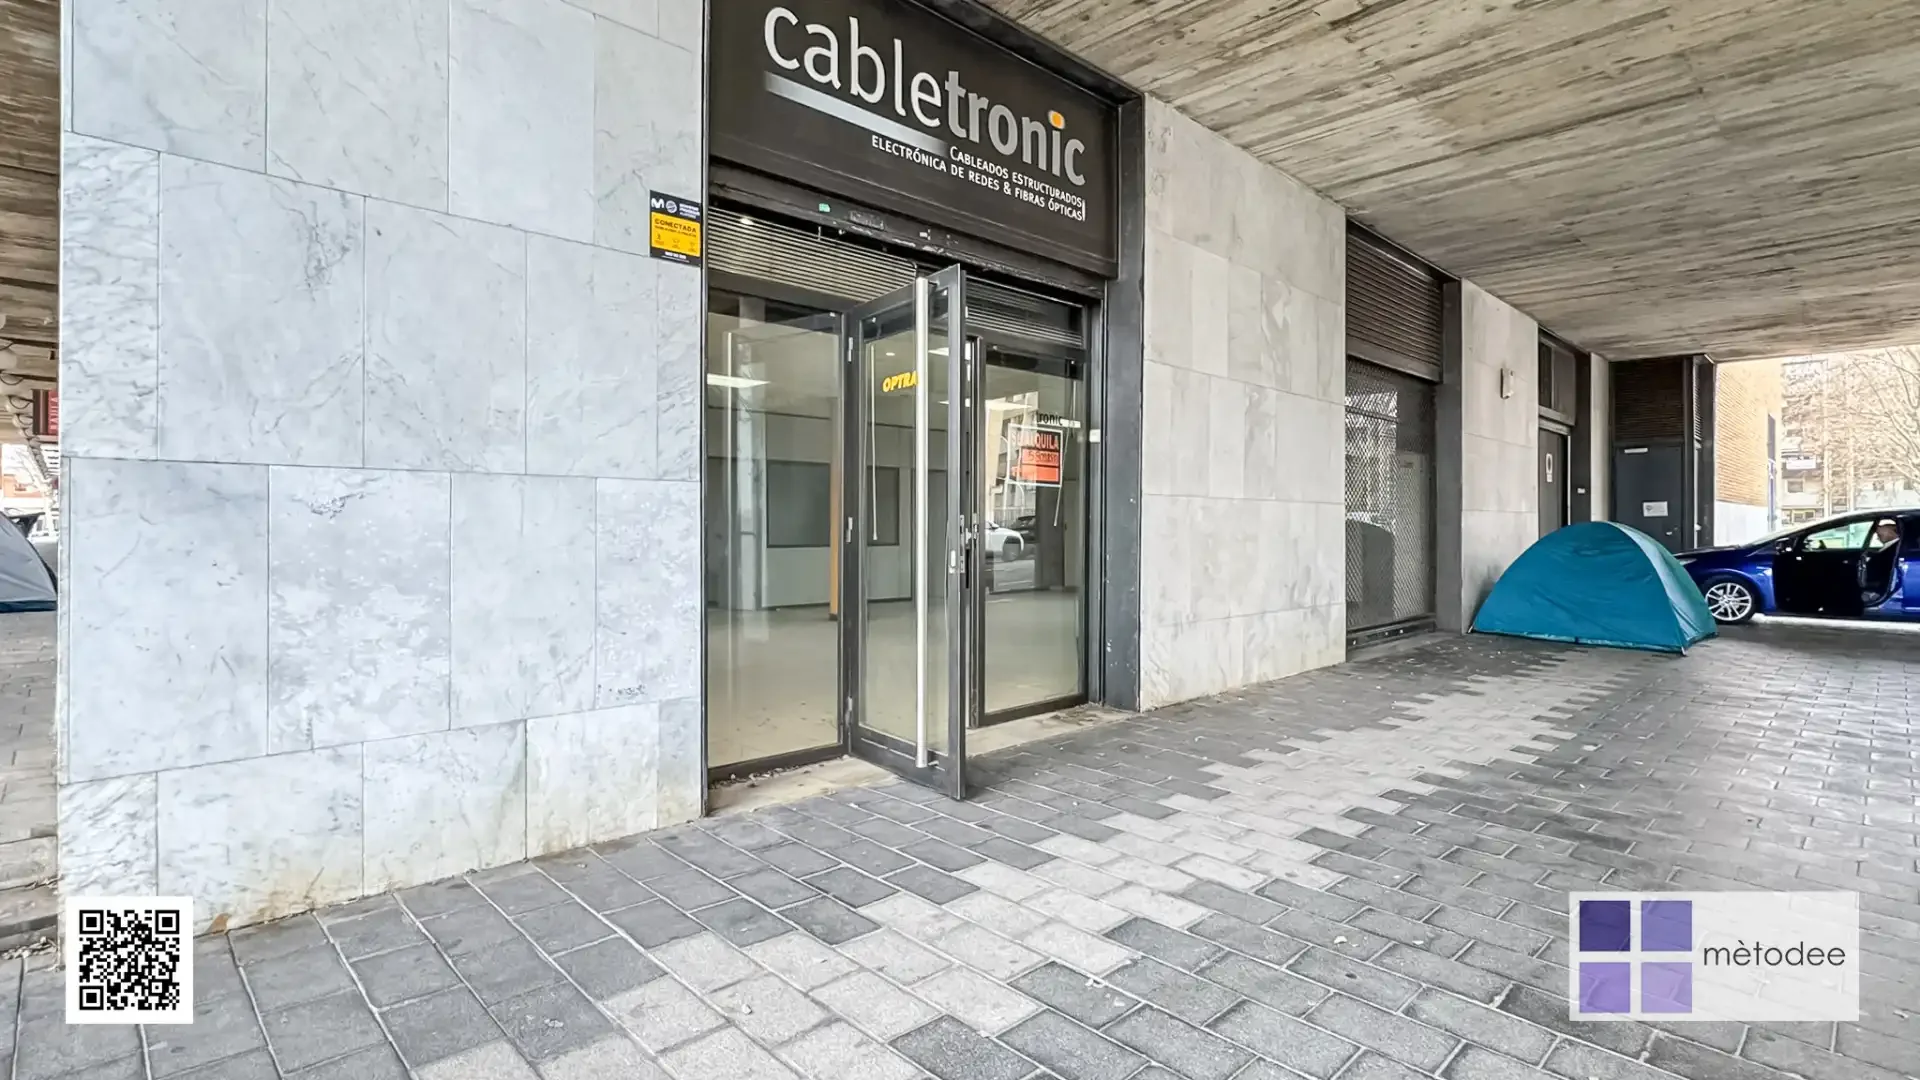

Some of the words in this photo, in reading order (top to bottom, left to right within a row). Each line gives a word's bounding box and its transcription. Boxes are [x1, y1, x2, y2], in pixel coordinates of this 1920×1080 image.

[764, 6, 1087, 187] cabletronic
[871, 134, 947, 173] ELECTRÓNICA
[950, 163, 965, 179] DE
[968, 169, 1000, 191] REDES
[1002, 181, 1013, 196] &
[1014, 186, 1046, 208] FIBRAS
[1047, 197, 1084, 222] ÓPTICAS
[949, 145, 1009, 180] CABLEADOS
[1011, 171, 1083, 208] ESTRUCTURADOS
